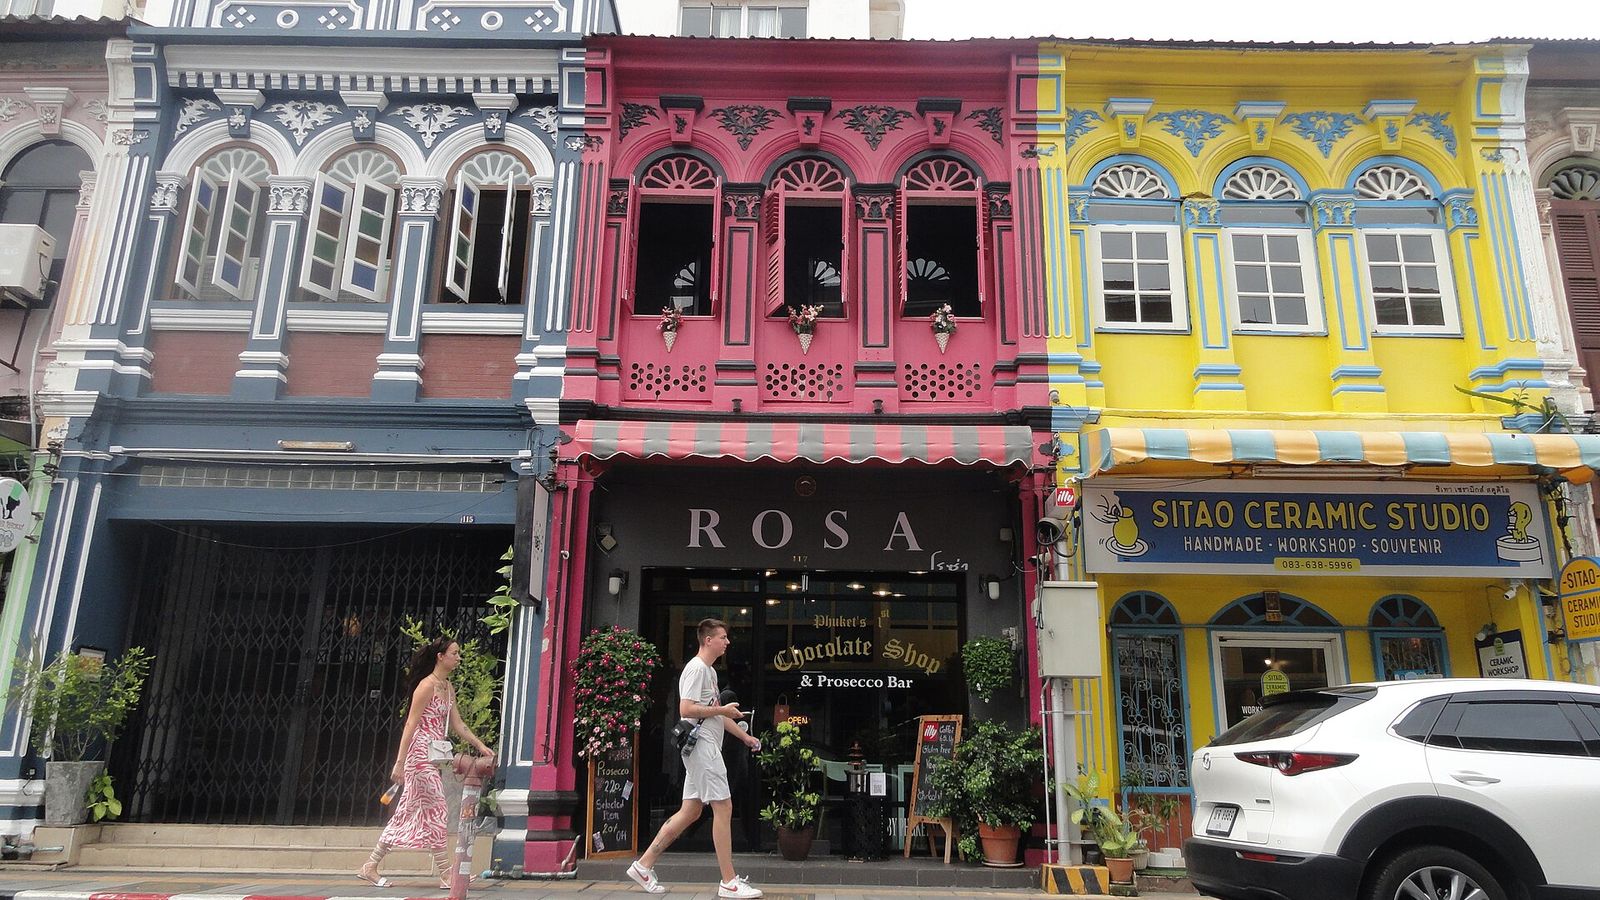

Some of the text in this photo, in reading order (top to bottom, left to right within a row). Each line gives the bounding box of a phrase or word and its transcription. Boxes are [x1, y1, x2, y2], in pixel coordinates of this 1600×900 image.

[1056, 489, 1074, 506] illy
[463, 515, 475, 524] 115
[1151, 500, 1490, 532] SITAO CERAMIC STUDIO
[686, 508, 924, 551] ROSA
[1184, 536, 1442, 554] HANDMADE WORKSHOP SOUVENIR
[930, 550, 969, 571] โรซ่า
[1282, 559, 1354, 570] 083-638-5996
[1567, 596, 1600, 613] CERAMI
[813, 614, 867, 629] Phuket's
[1573, 613, 1600, 629] STUDI
[773, 636, 942, 676] Chocolate Shop
[1489, 656, 1514, 667] CERAMIC
[1487, 665, 1520, 677] WORKSHOP
[800, 674, 914, 689] & Prosecco Bar
[787, 716, 808, 725] OPEN
[924, 724, 938, 740] illy
[597, 760, 629, 776] Prosecco
[596, 799, 625, 810] Selected
